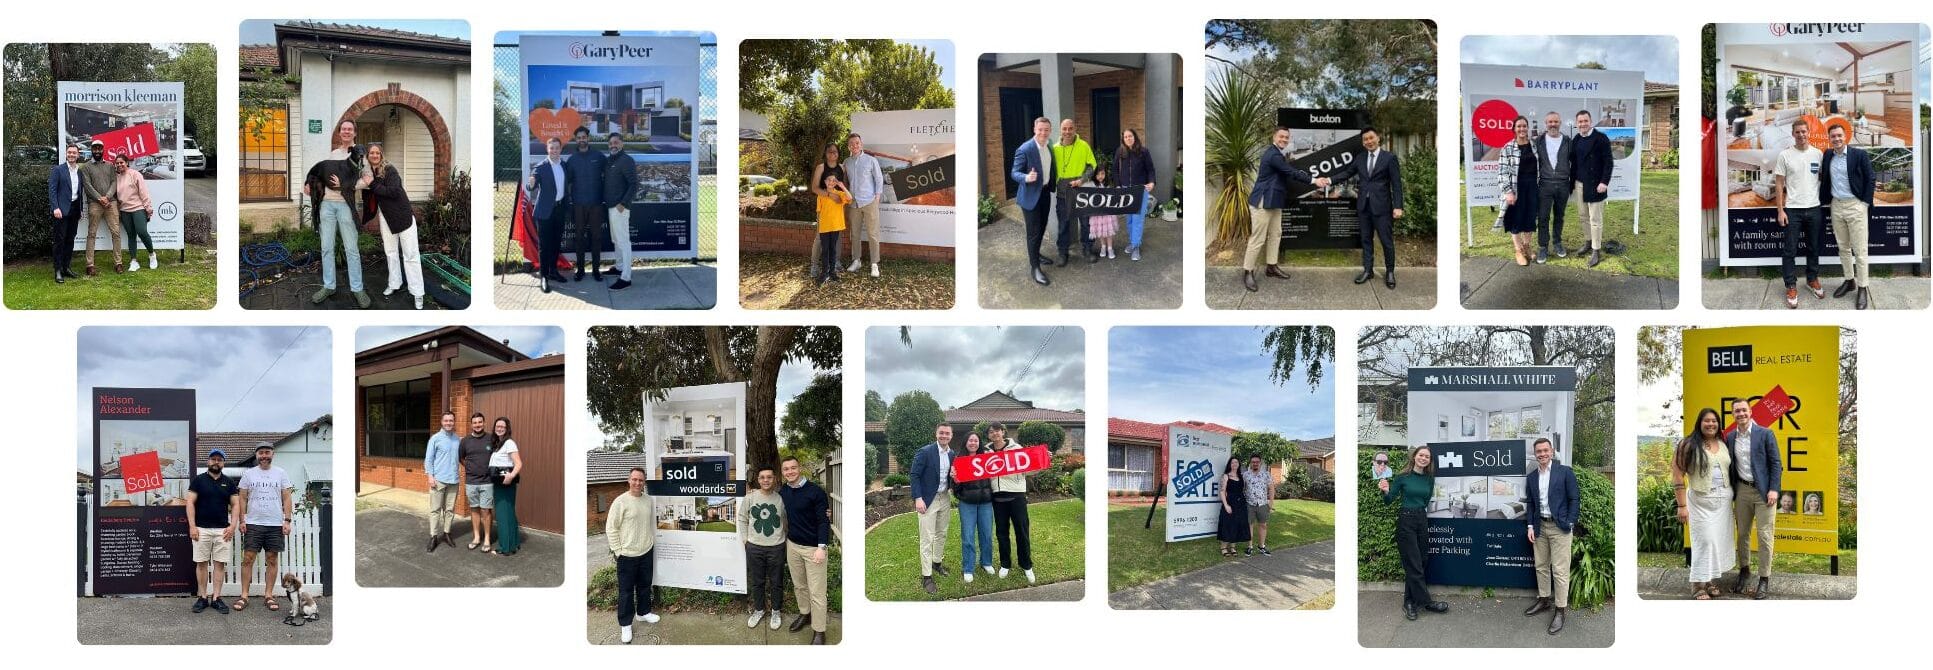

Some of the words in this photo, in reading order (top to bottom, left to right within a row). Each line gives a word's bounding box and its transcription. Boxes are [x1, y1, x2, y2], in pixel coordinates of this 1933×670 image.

[583, 43, 653, 60] GaryPeer
[1527, 80, 1599, 91] BARRYPLANT
[65, 89, 123, 101] morrison
[125, 89, 177, 101] kleeman
[1310, 114, 1341, 123] buxton
[1479, 118, 1514, 130] SOLD
[1309, 151, 1353, 178] SOLD
[906, 167, 945, 190] Sold
[1075, 192, 1134, 208] SOLD
[161, 206, 174, 215] mk
[1733, 231, 1740, 239] A
[1742, 230, 1768, 240] family
[1734, 241, 1752, 249] with
[1712, 351, 1748, 367] BELL
[1755, 356, 1776, 365] REAL
[1780, 354, 1812, 363] ESTATE
[1441, 374, 1510, 385] MARSHALL
[1513, 374, 1556, 385] WHITE
[100, 395, 134, 404] Nelson
[100, 405, 151, 414] Alexander
[1720, 396, 1801, 430] FR
[971, 451, 1031, 477] SOLD
[1473, 450, 1513, 467] Sold
[666, 466, 697, 480] sold
[127, 472, 161, 491] Sold
[1176, 469, 1203, 490] SOLD
[679, 484, 726, 494] woodards
[1175, 482, 1218, 498] ALE
[1427, 525, 1455, 534] elessly
[1428, 536, 1454, 544] ovated
[1455, 536, 1473, 544] with
[1441, 546, 1471, 556] Parking
